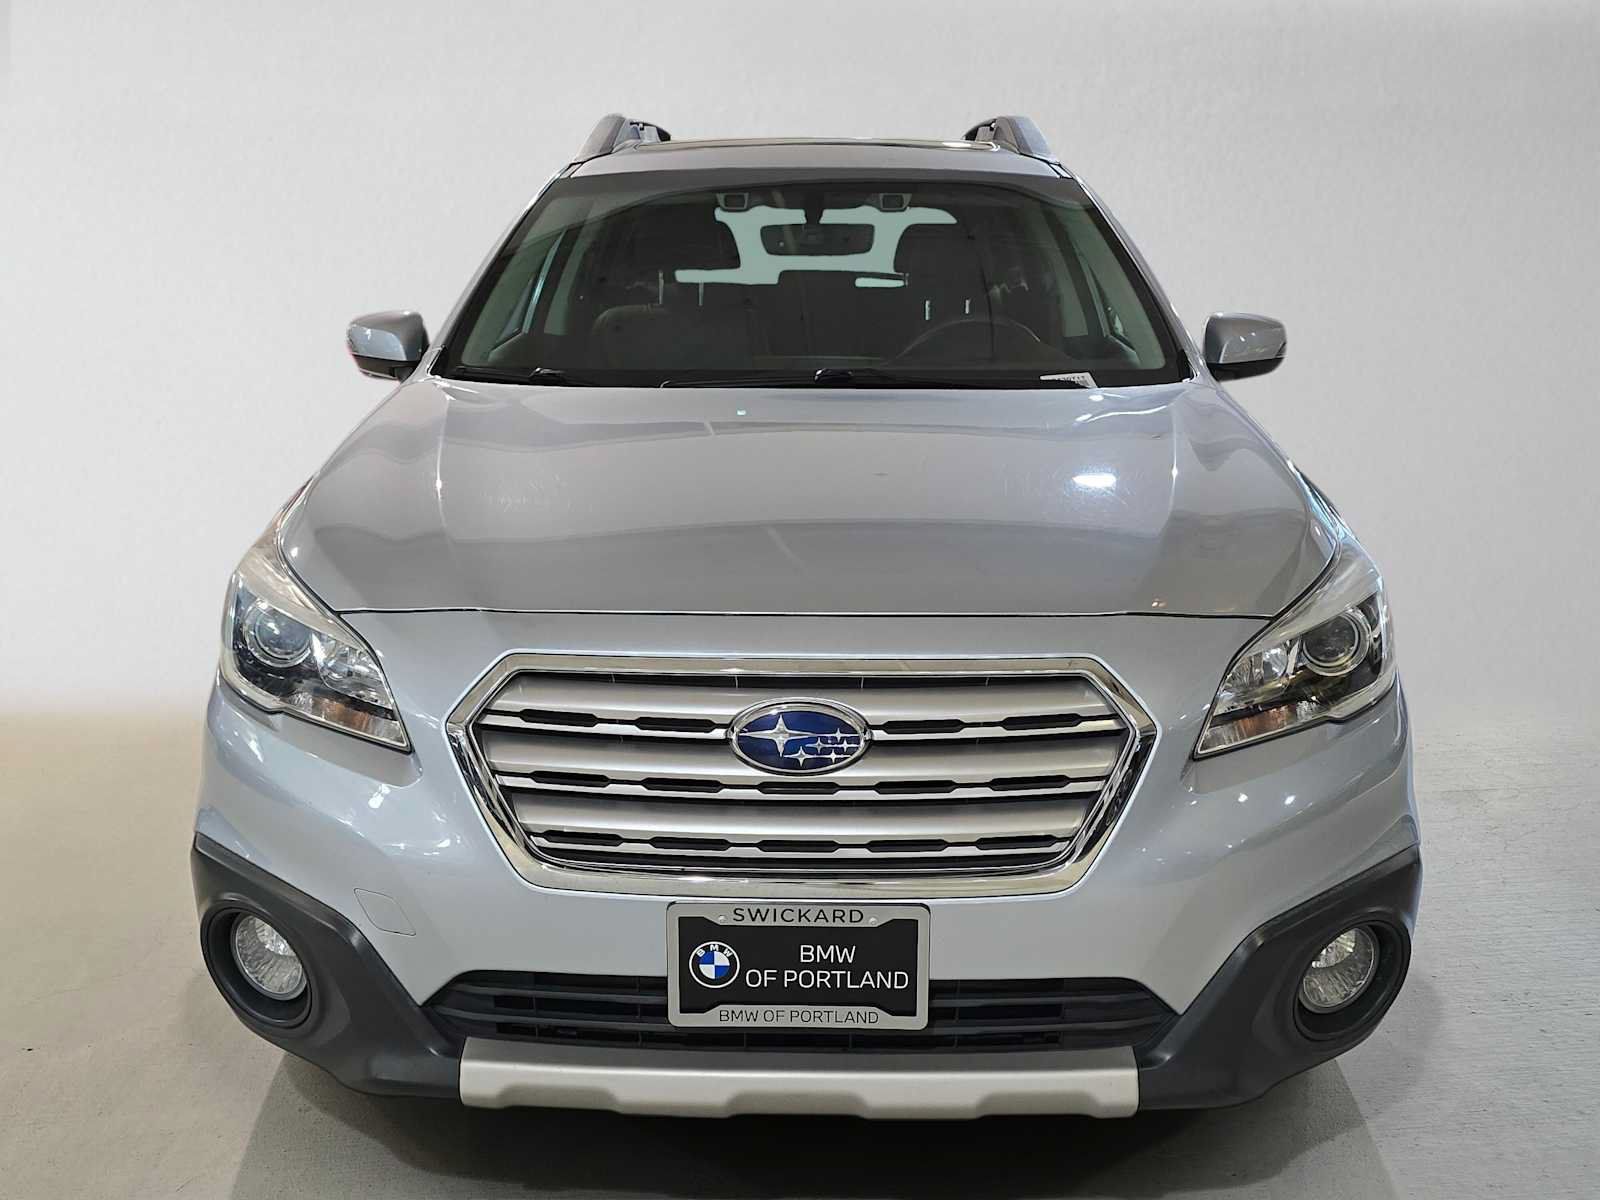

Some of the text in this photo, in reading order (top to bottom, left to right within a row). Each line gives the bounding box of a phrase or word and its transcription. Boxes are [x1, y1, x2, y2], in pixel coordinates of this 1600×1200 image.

[732, 908, 865, 924] SWICKARD
[799, 944, 856, 963] BMW
[745, 969, 909, 989] OF PORTLAND
[718, 1009, 879, 1024] BMW OF PORTLAND
